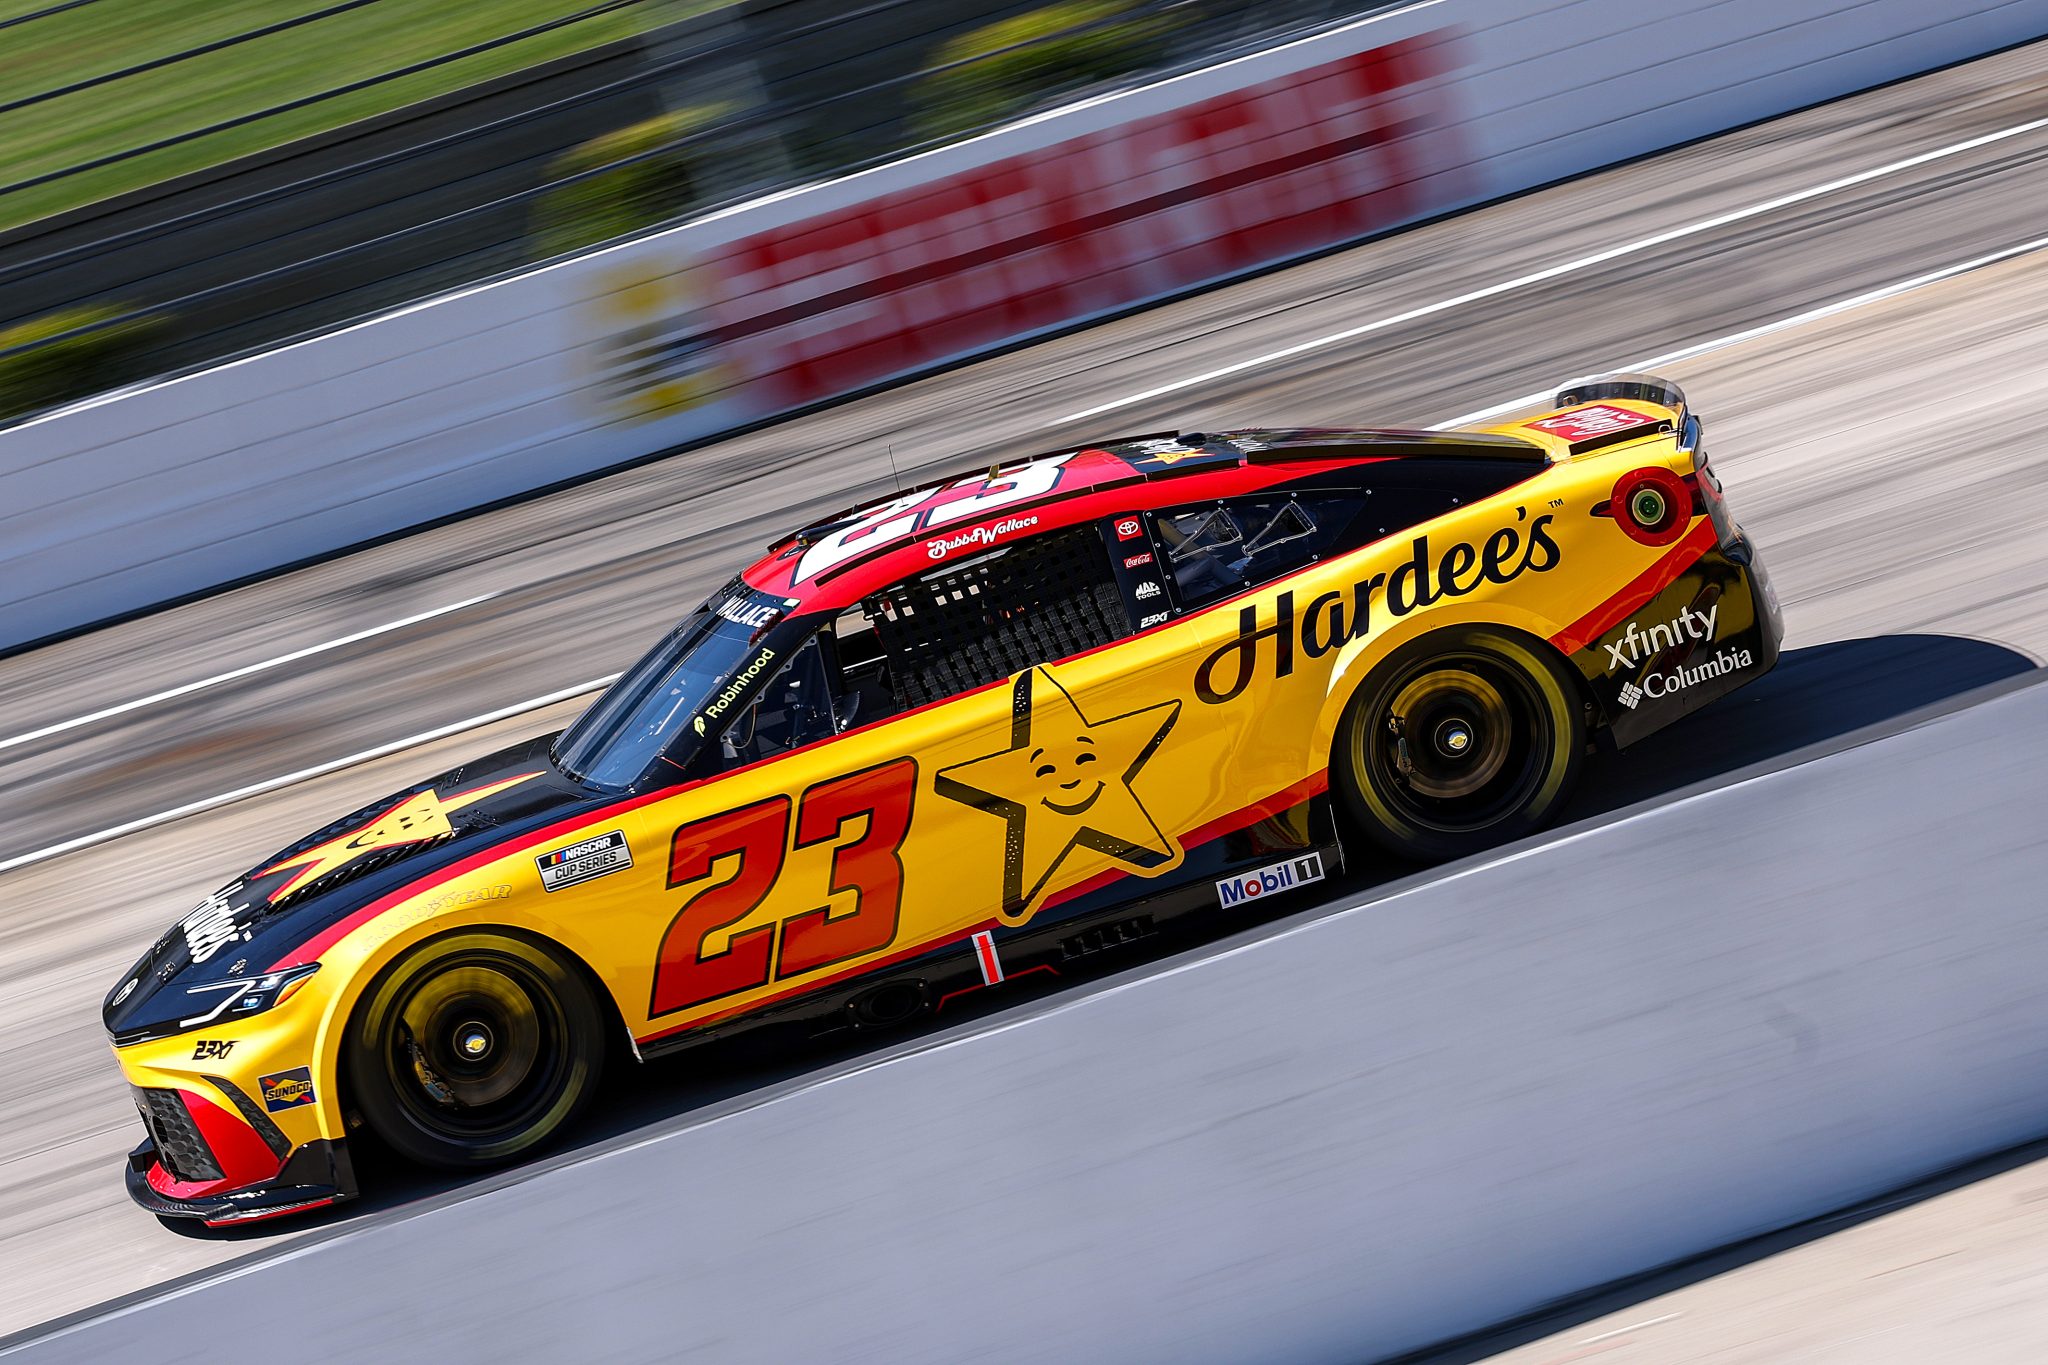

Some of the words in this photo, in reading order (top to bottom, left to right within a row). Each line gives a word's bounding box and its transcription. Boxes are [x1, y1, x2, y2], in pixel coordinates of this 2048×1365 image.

[789, 451, 1083, 589] 23
[927, 533, 979, 559] Bubba
[973, 516, 1039, 544] Wallace
[1136, 581, 1160, 597] MAC
[1136, 590, 1161, 600] TOOLS
[1194, 505, 1561, 705] Hardee's
[715, 595, 779, 628] WALLACE
[1603, 604, 1718, 670] xfinity
[705, 647, 776, 719] Robinhood
[1643, 646, 1753, 698] Columbia
[555, 864, 577, 879] CUP
[578, 851, 617, 873] SERIES
[565, 837, 611, 860] NASCAR
[647, 755, 919, 1021] 23
[1220, 863, 1293, 905] Mobil
[1301, 860, 1312, 878] 1
[268, 1082, 310, 1100] SUNOCO
